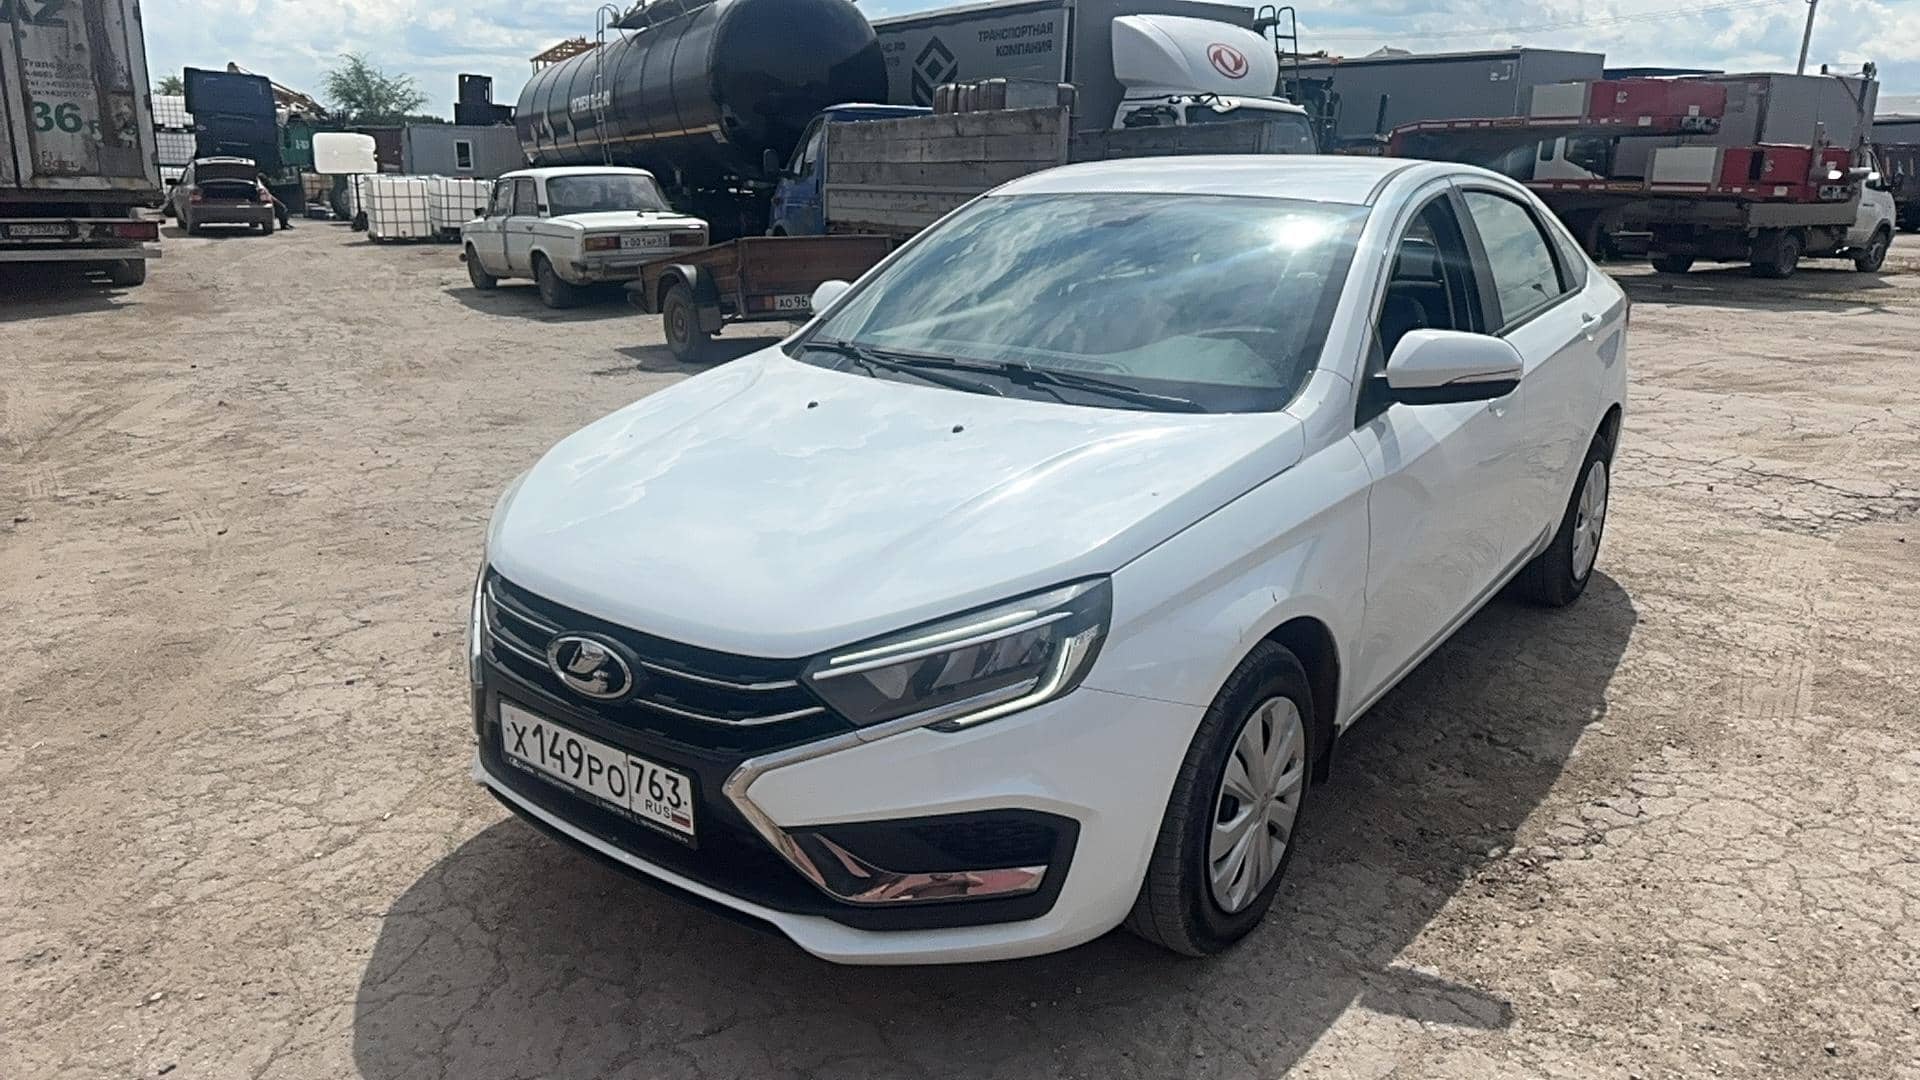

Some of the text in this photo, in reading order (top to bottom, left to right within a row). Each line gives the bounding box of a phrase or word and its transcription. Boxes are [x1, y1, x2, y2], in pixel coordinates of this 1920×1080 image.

[978, 22, 1054, 42] ТРАНСПОРТНАЯ
[996, 40, 1053, 56] КОМПАНИЯ
[511, 722, 626, 797] Х149РО
[630, 760, 681, 808] 763
[645, 800, 672, 819] RUS
